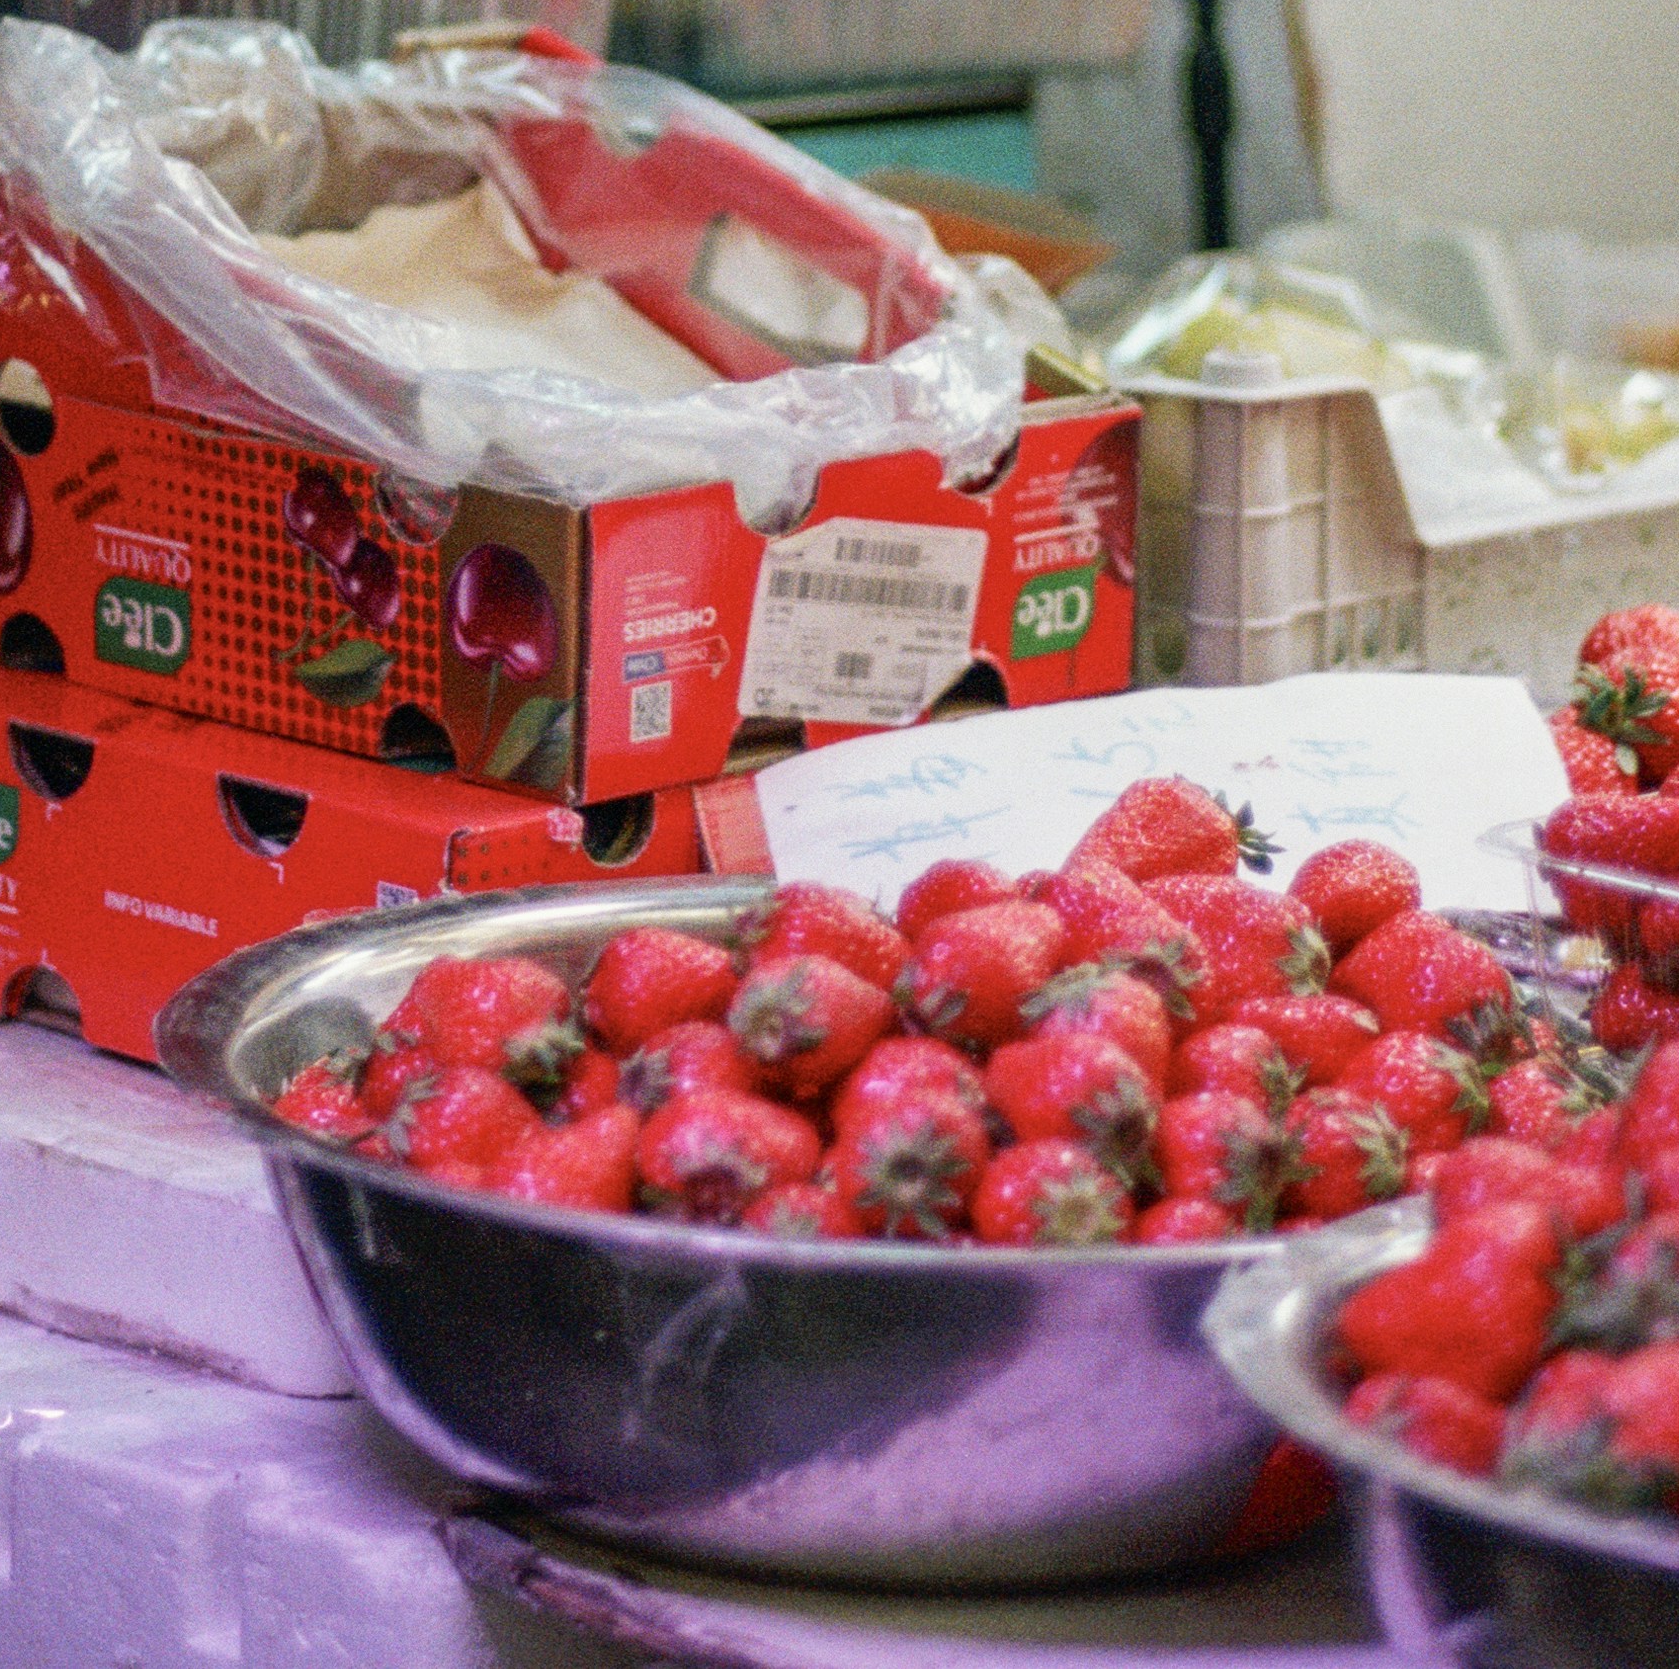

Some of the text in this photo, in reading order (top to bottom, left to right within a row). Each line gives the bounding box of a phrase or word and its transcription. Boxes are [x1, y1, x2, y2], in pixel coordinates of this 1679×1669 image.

[94, 535, 192, 583] QUALITY
[1013, 530, 1100, 573] QUALITY
[623, 606, 718, 643] CHERRIES
[104, 890, 218, 938] INFO VARIABLE
